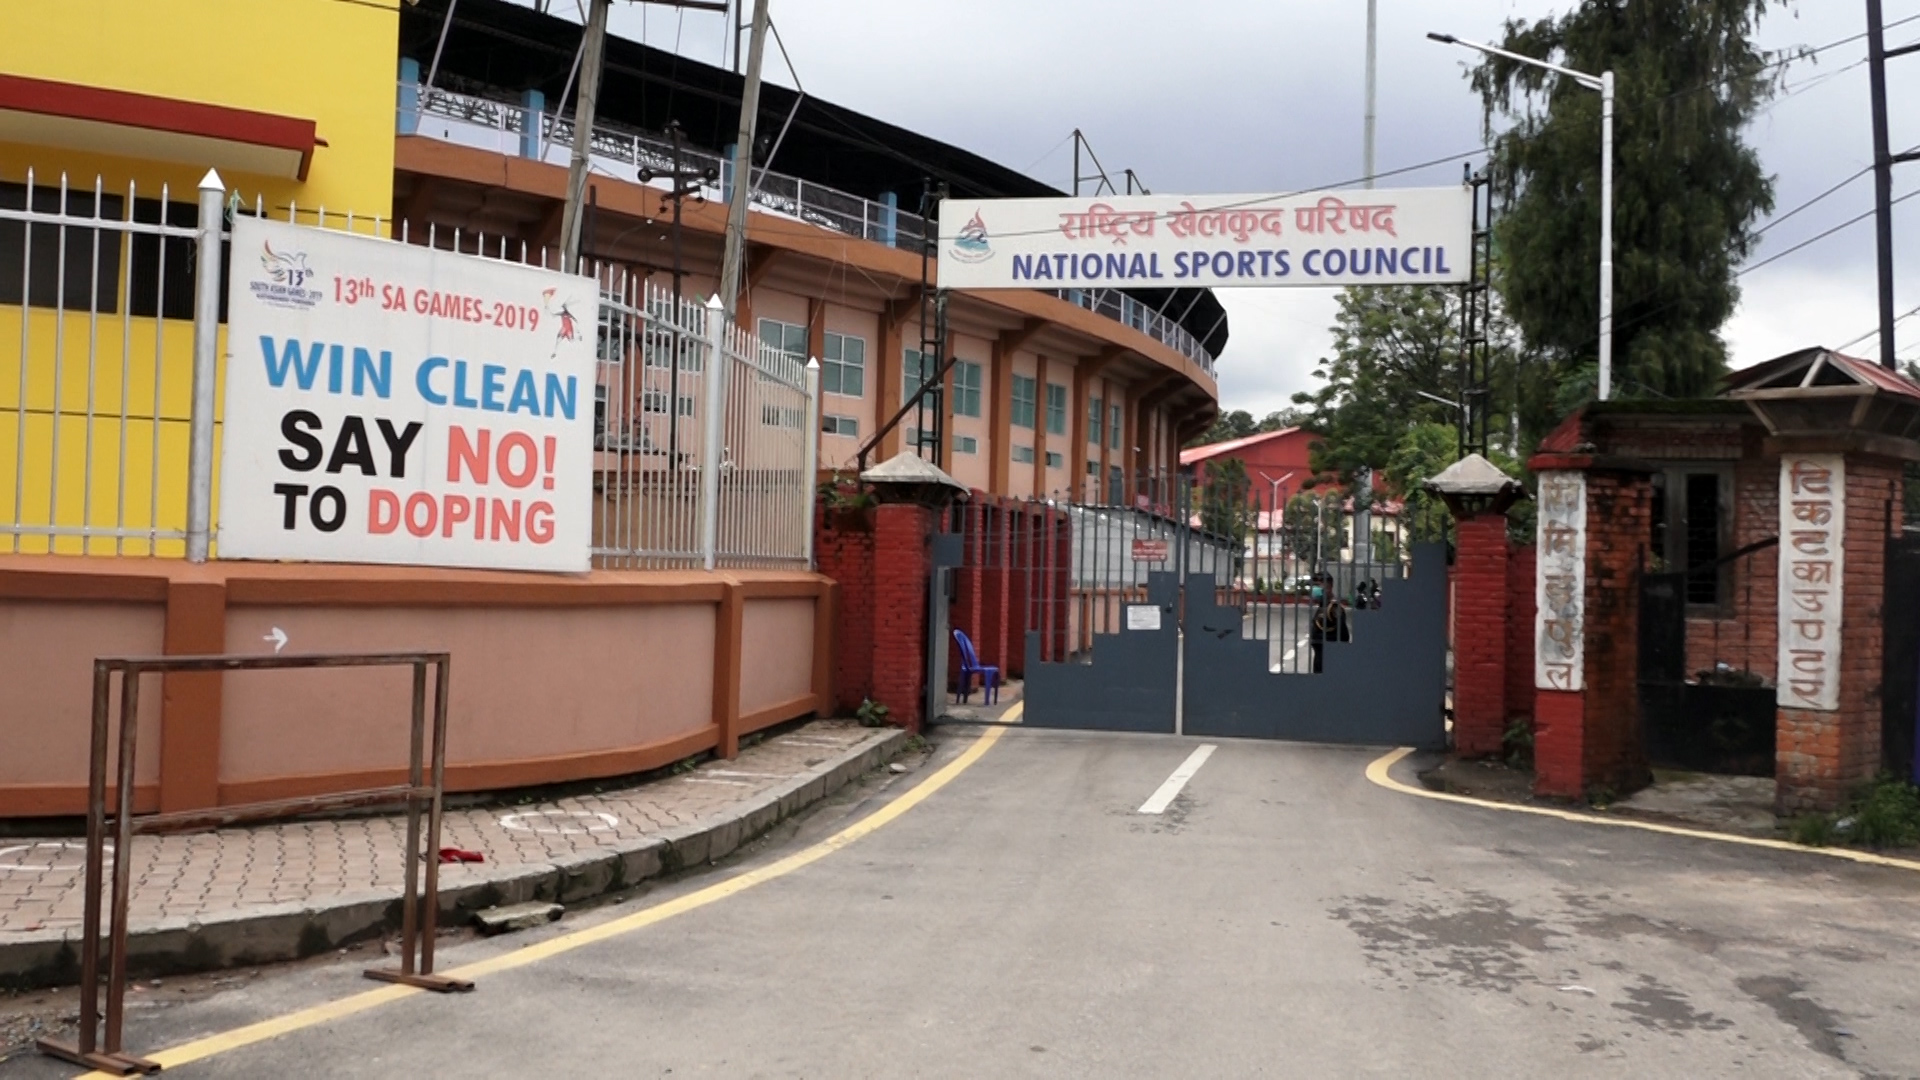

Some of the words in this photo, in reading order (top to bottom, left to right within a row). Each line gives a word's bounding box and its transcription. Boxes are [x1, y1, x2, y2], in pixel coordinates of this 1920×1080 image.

[1059, 203, 1156, 245] राष्ट्रिय
[1167, 201, 1284, 243] खेलकुद
[1295, 197, 1397, 237] परिषद
[1012, 253, 1163, 280] NATIONAL
[1174, 249, 1290, 278] SPORTS
[1302, 247, 1450, 276] COUNCIL
[333, 276, 375, 305] 13th
[381, 285, 407, 311] SA
[413, 289, 539, 332] GAMES-2019
[259, 335, 392, 398] WIN
[416, 357, 577, 420] CLEAN
[278, 409, 424, 479] SAY
[446, 425, 557, 491] NO!
[274, 483, 347, 533] TO
[367, 489, 556, 545] DOPING
